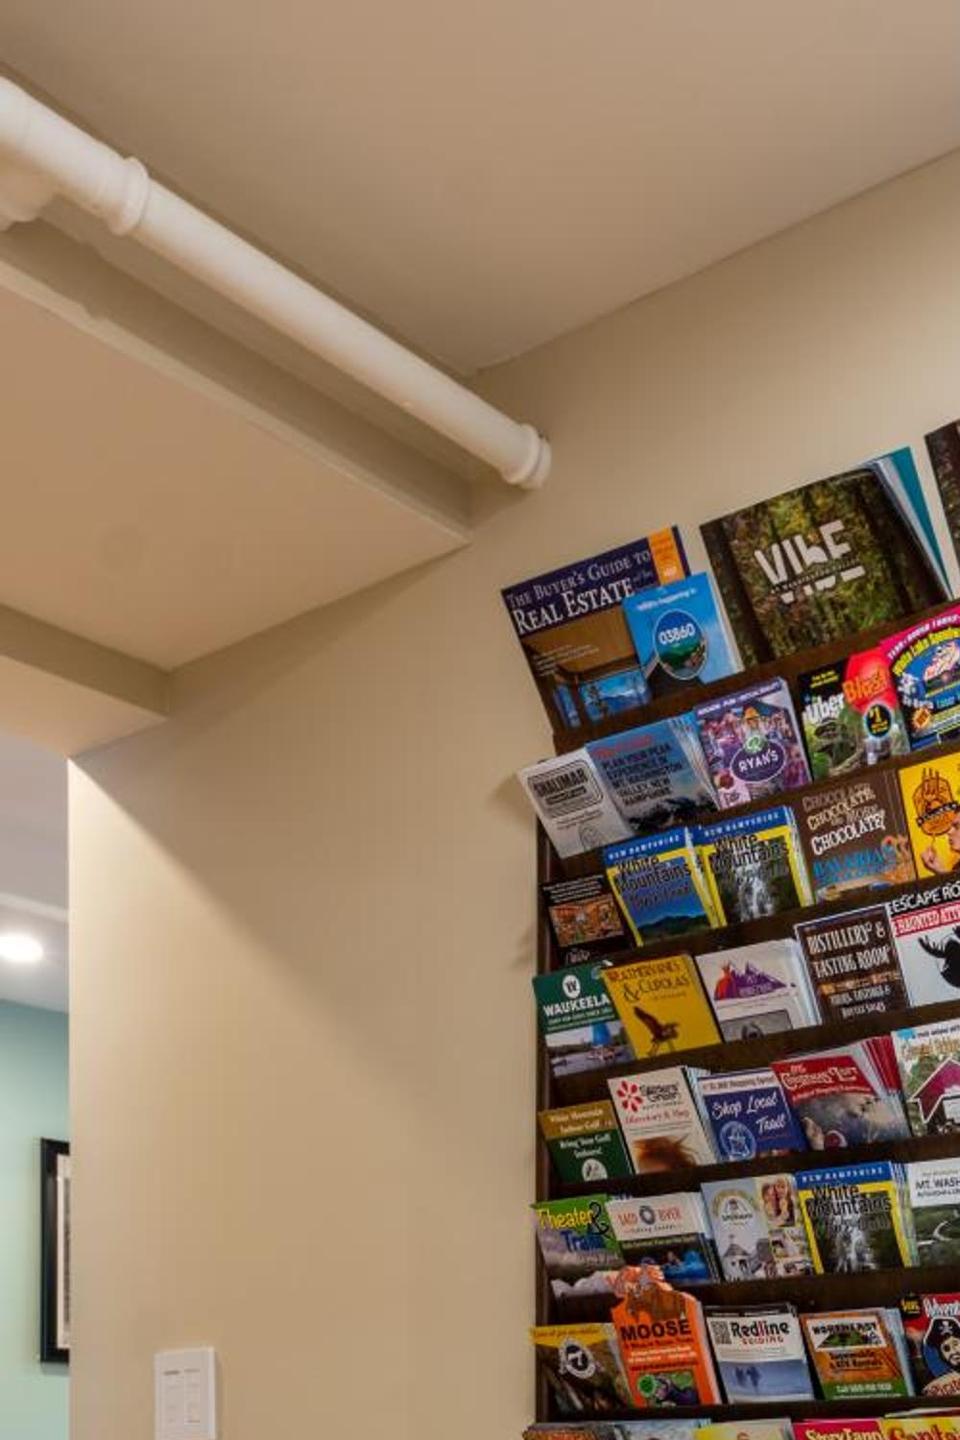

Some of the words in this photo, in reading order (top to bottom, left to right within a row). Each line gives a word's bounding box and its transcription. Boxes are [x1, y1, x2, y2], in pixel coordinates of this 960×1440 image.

[514, 608, 563, 635] REAL
[562, 578, 635, 615] ESTATE
[658, 623, 695, 644] 03860
[738, 750, 780, 773] RYAN'S
[616, 855, 659, 875] White
[806, 921, 873, 954] DISTILLERY
[814, 954, 855, 978] TASTING
[856, 946, 890, 968] ROOM
[543, 993, 611, 1017] WAUKEELA
[712, 1101, 743, 1120] Shop
[746, 1093, 777, 1114] Local
[811, 1183, 859, 1200] White
[806, 1197, 893, 1217] Mountains
[620, 1318, 692, 1341] MOOSE
[731, 1320, 790, 1337] Redline
